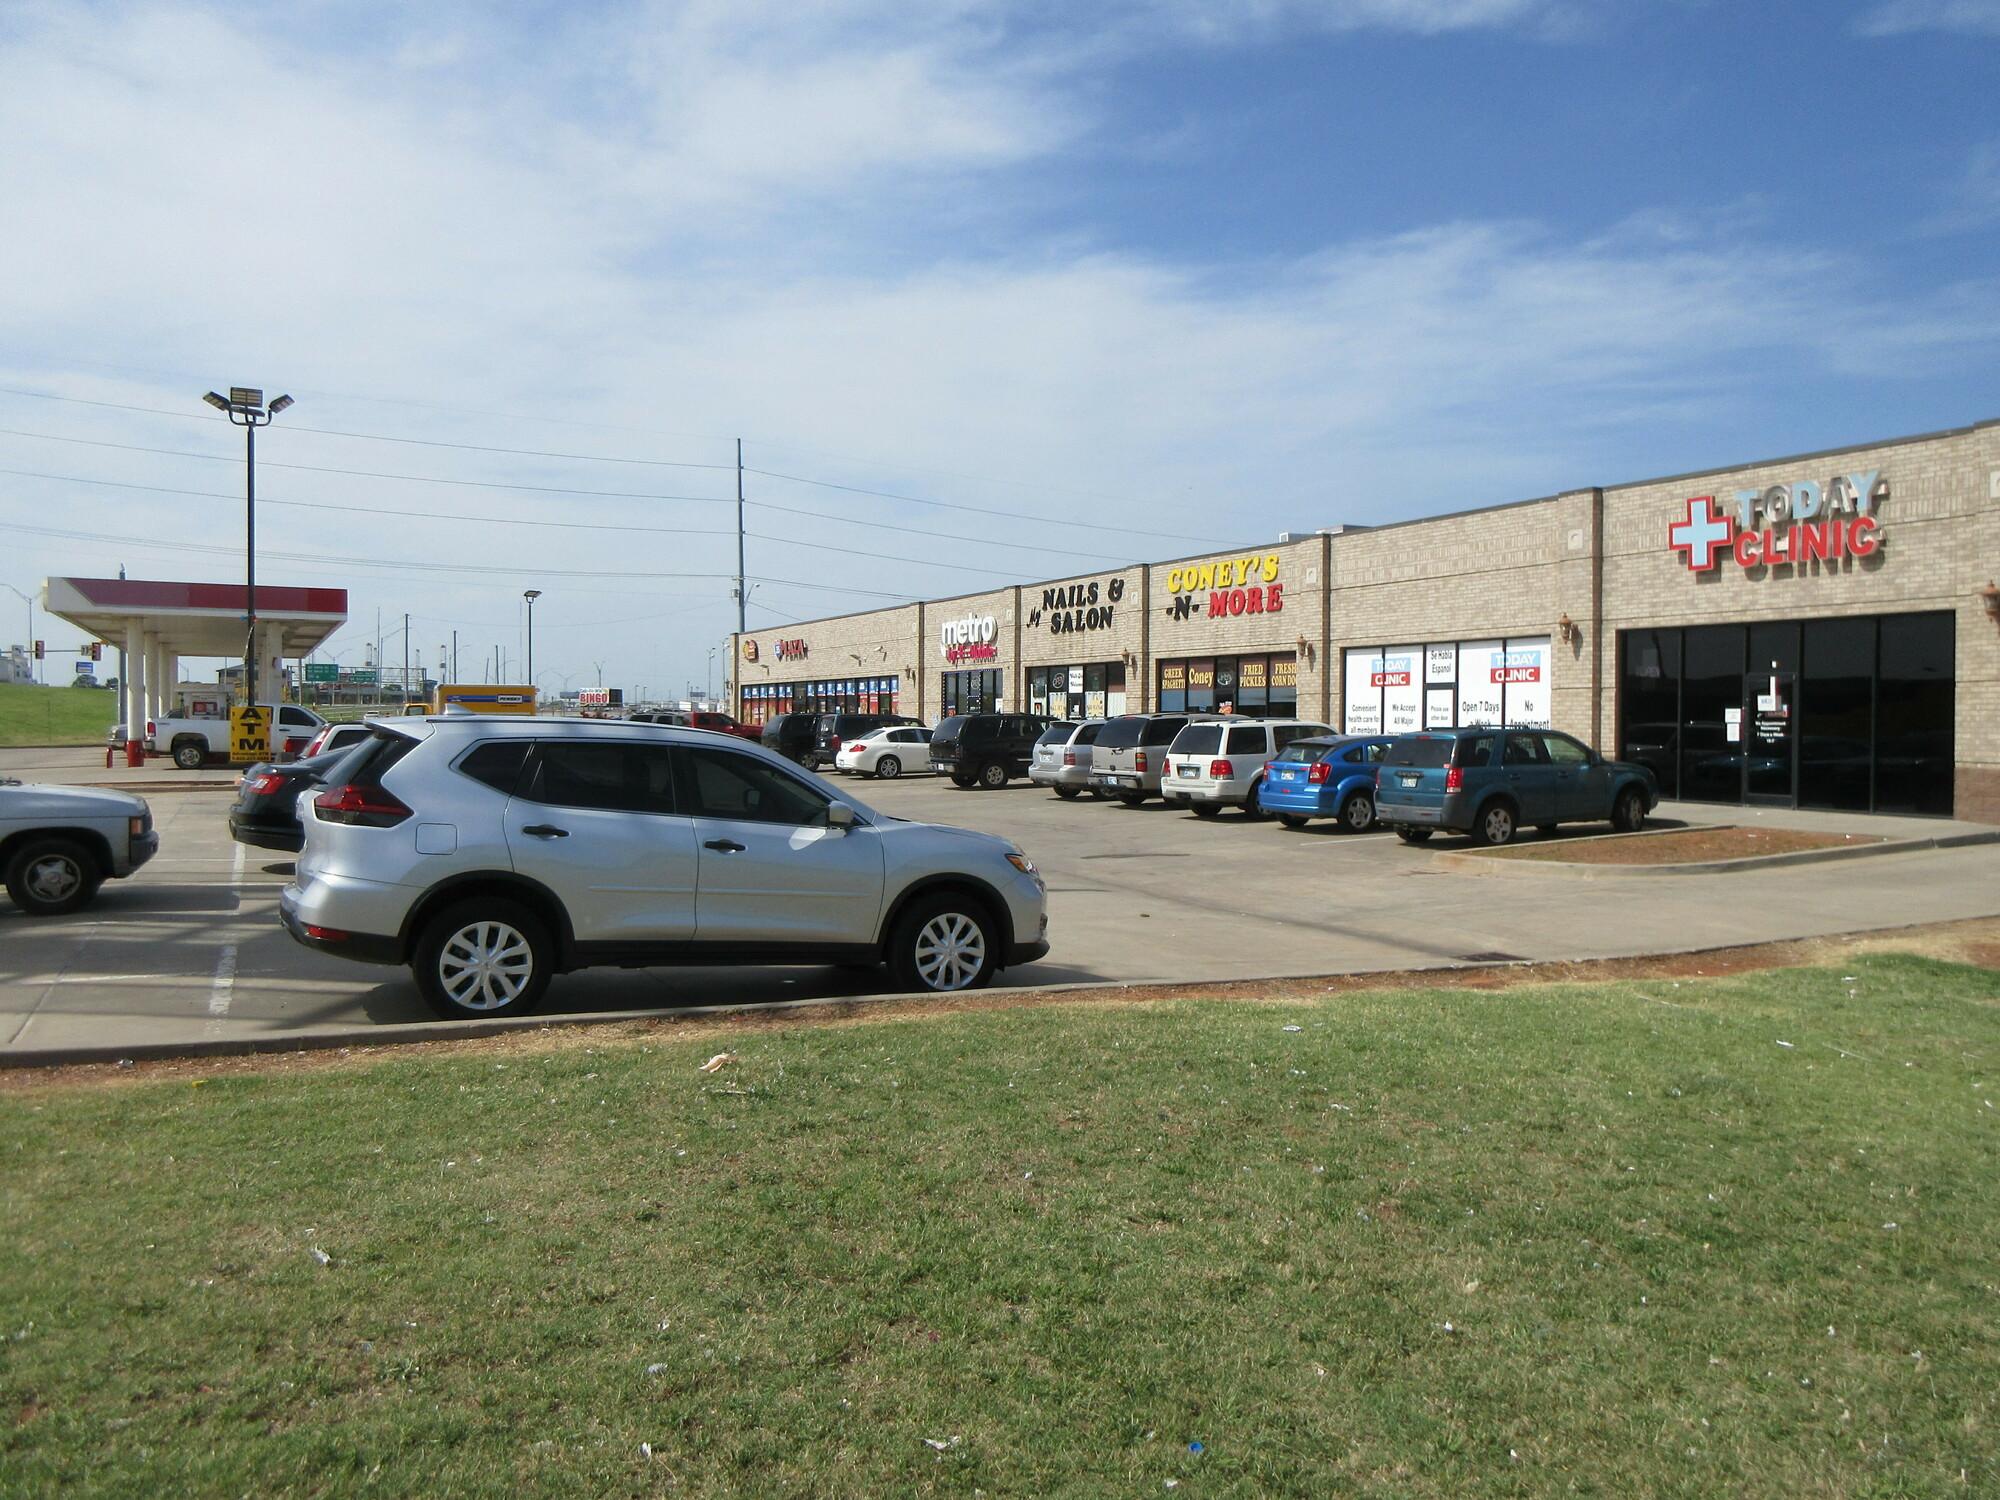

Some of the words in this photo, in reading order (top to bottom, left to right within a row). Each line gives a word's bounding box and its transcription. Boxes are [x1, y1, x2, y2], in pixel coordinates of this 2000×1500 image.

[1733, 470, 1879, 527] TODAY
[1733, 516, 1880, 568] CLINIC
[1167, 554, 1279, 593] CONEY'S
[1042, 582, 1099, 611] NAILS
[1108, 578, 1125, 602] &
[1208, 583, 1283, 618] MORE
[1050, 605, 1114, 635] SALON
[941, 612, 996, 645] metro
[1431, 650, 1437, 660] Se
[1438, 649, 1452, 660] Habla
[1164, 668, 1183, 679] GREEK
[1243, 664, 1264, 676] FRIED
[1275, 662, 1297, 675] FRESH
[1495, 668, 1535, 682] CLINIC
[1188, 667, 1214, 687] Coney
[1240, 676, 1267, 687] PICKLES
[1271, 675, 1287, 687] CORN
[580, 693, 608, 703] BINGO
[1351, 704, 1377, 712] Convenient
[1392, 704, 1399, 712] We
[1400, 704, 1416, 713] Accept
[1462, 701, 1478, 714] Open
[1479, 701, 1483, 712] 7
[1484, 701, 1500, 714] Days
[1524, 700, 1534, 712] No
[1401, 717, 1414, 726] Major
[239, 707, 265, 751] ATM
